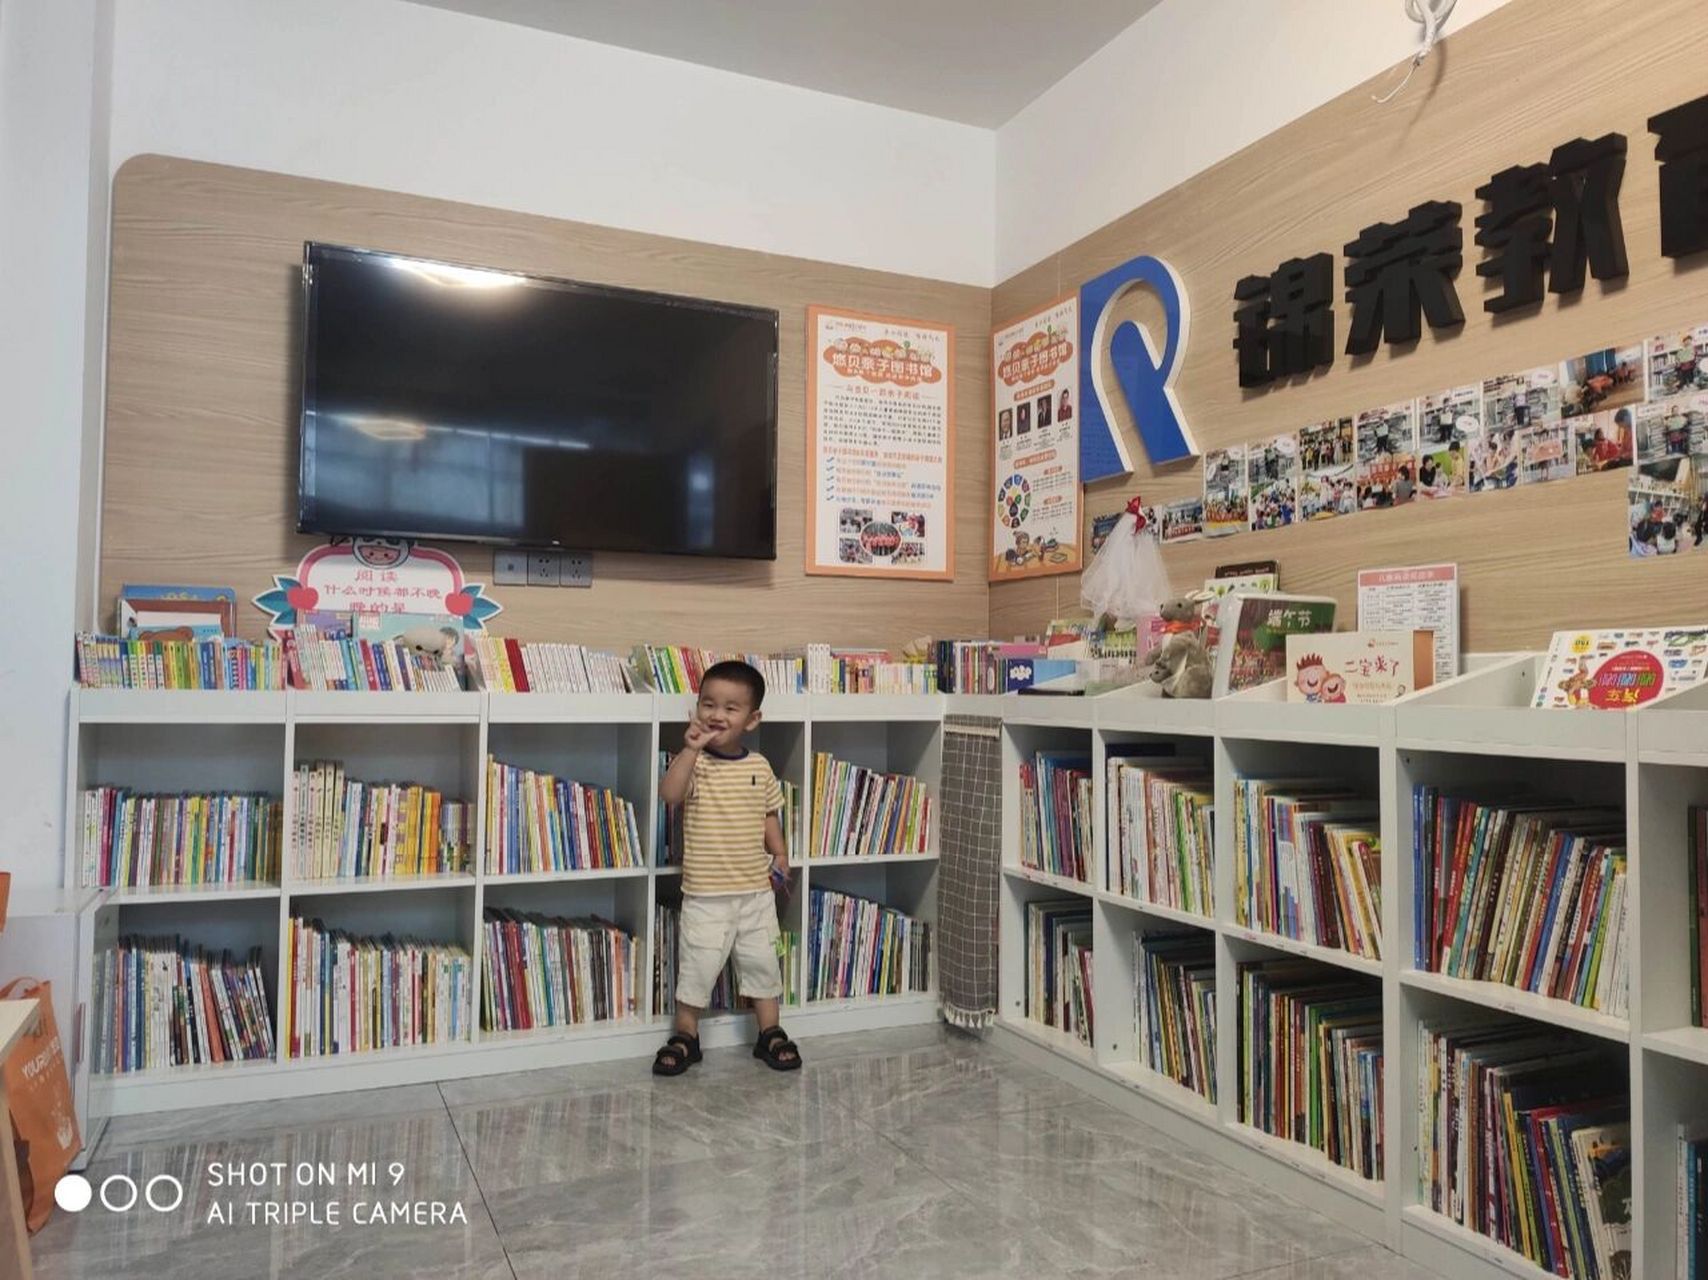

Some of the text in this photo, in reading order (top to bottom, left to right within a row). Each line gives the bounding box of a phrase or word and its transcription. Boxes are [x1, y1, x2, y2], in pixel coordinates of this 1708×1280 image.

[354, 569, 398, 582] 阅读
[323, 584, 442, 599] 什么时候都不晚
[1266, 608, 1313, 629] 端午节
[1344, 654, 1400, 677] 二宝来了
